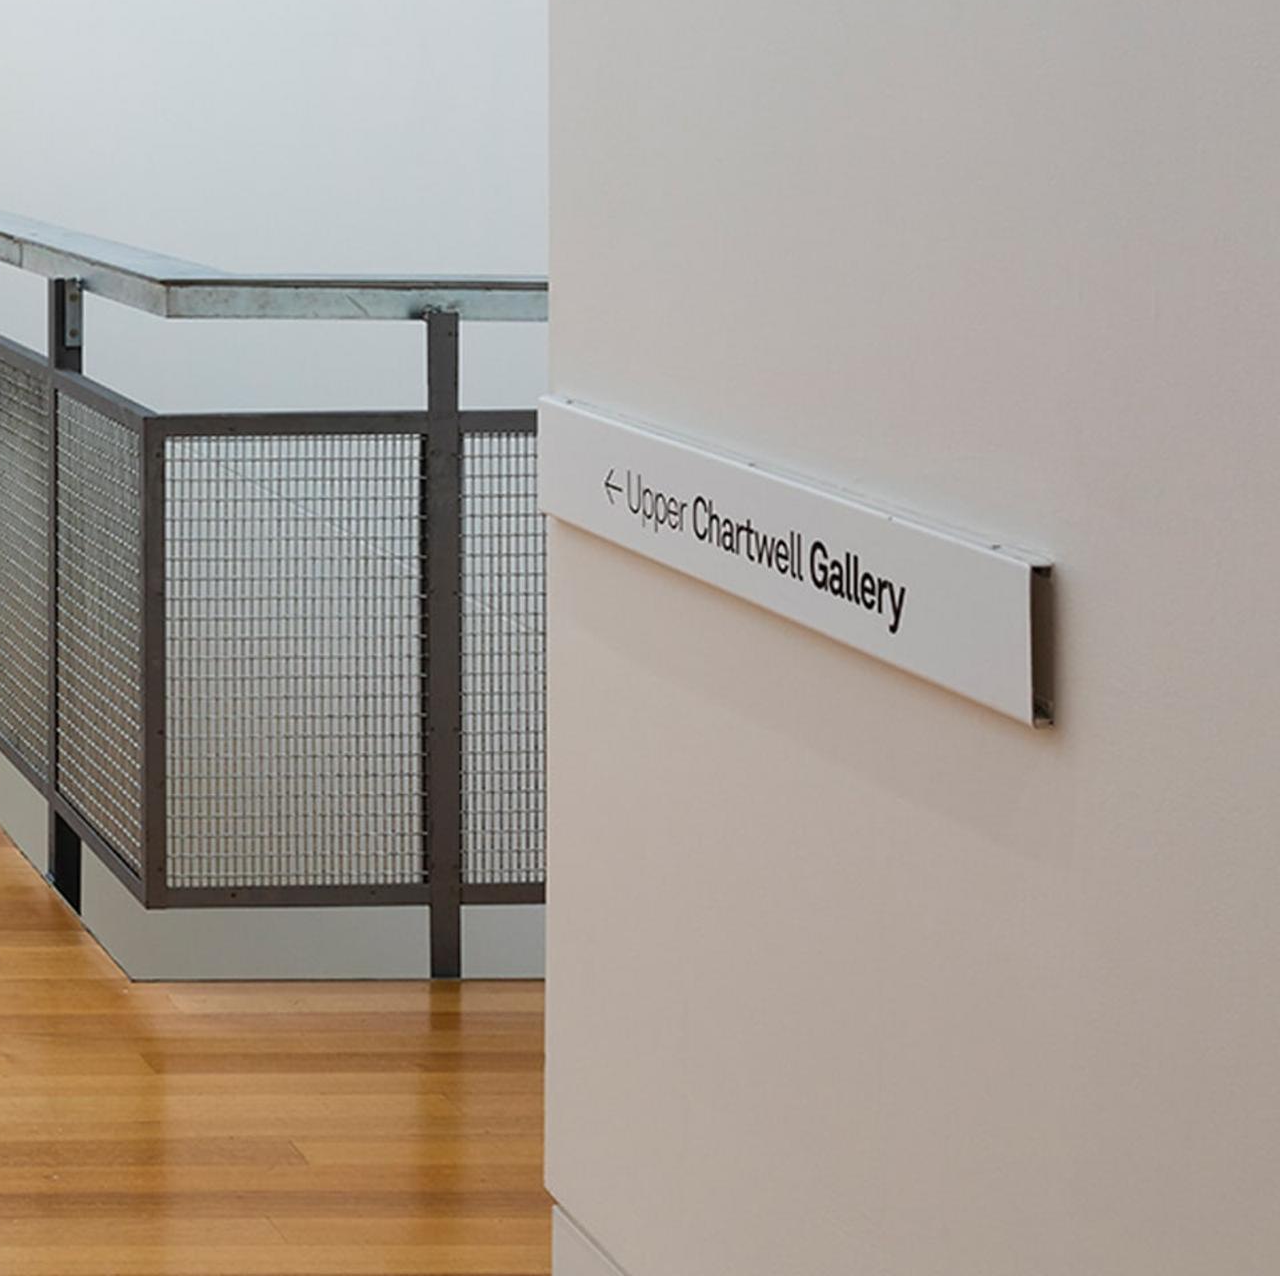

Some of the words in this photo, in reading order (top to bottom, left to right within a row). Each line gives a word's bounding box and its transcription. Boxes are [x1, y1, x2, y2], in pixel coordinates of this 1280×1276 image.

[627, 470, 688, 533] Upper
[693, 496, 804, 582] Chartwell
[810, 540, 906, 634] Gallery
